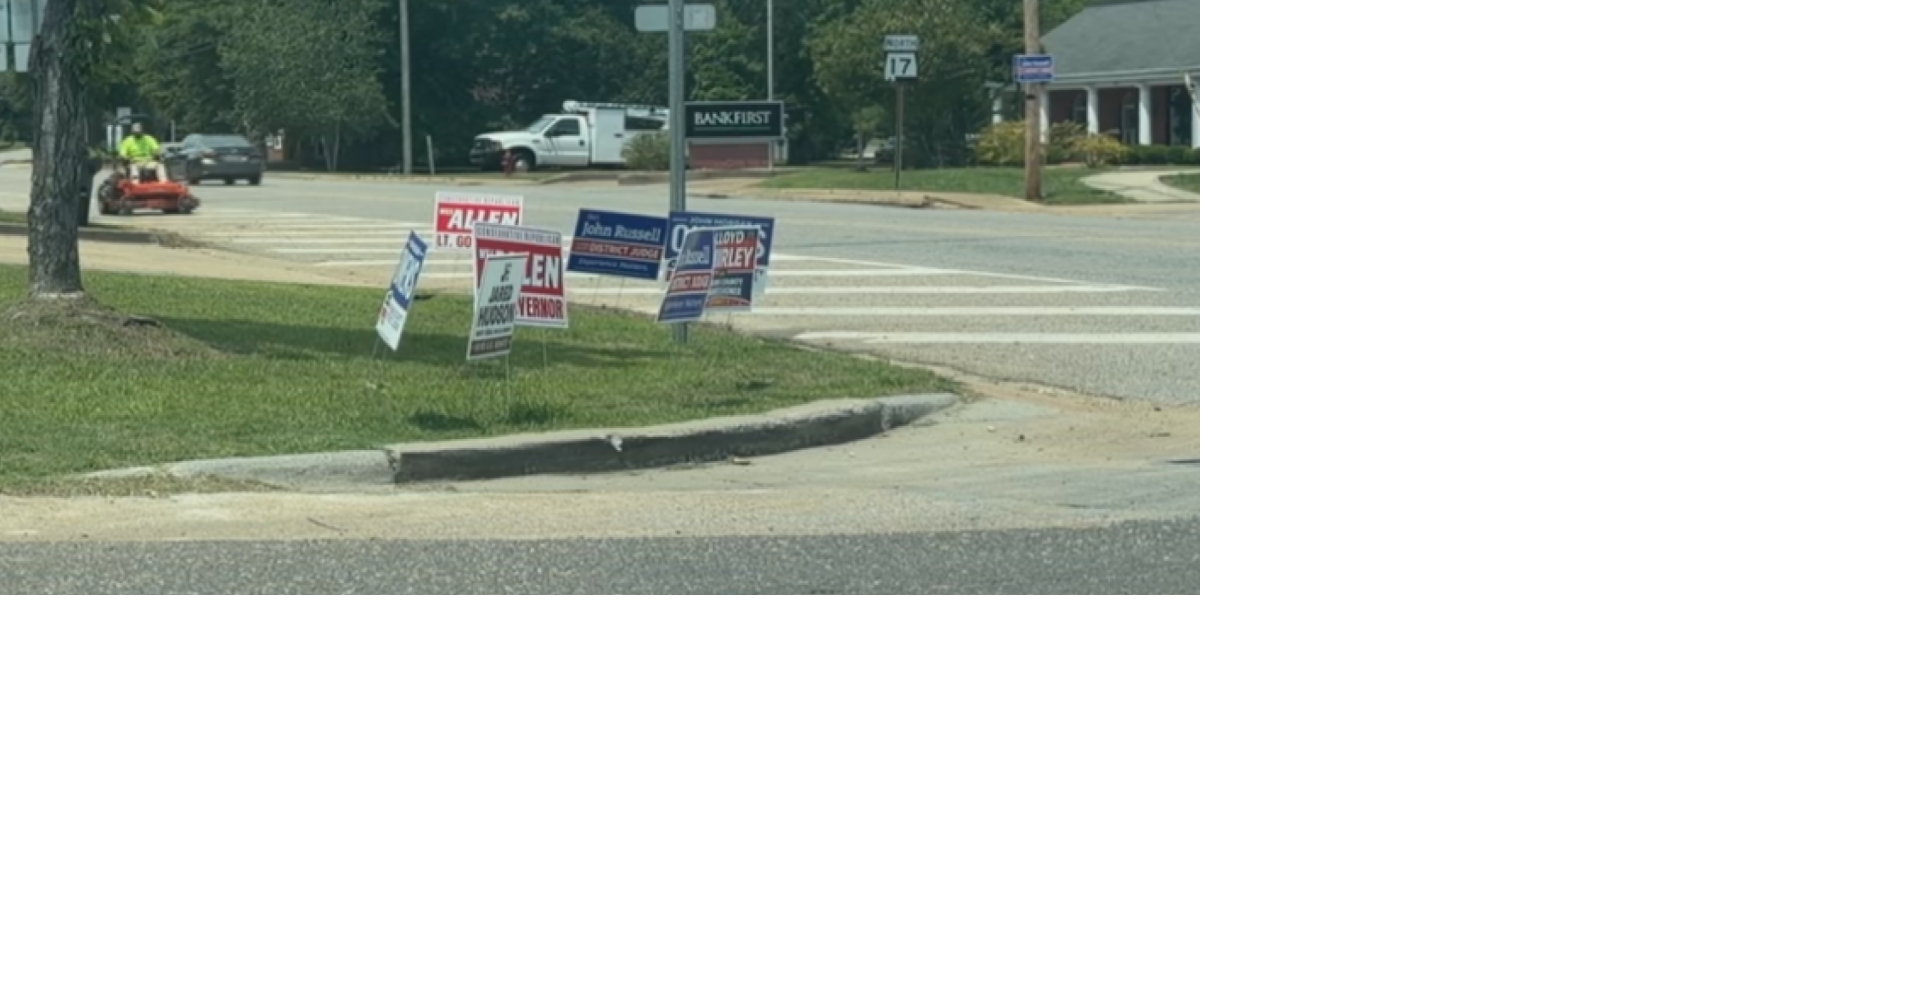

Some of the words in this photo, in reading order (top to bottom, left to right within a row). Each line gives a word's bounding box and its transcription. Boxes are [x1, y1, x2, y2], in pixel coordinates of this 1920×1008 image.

[890, 58, 912, 75] 17
[694, 110, 771, 125] BANKFIRST
[447, 208, 518, 230] ALLEN
[581, 221, 613, 237] John
[614, 225, 662, 242] Russell
[589, 241, 630, 255] DISTRICT
